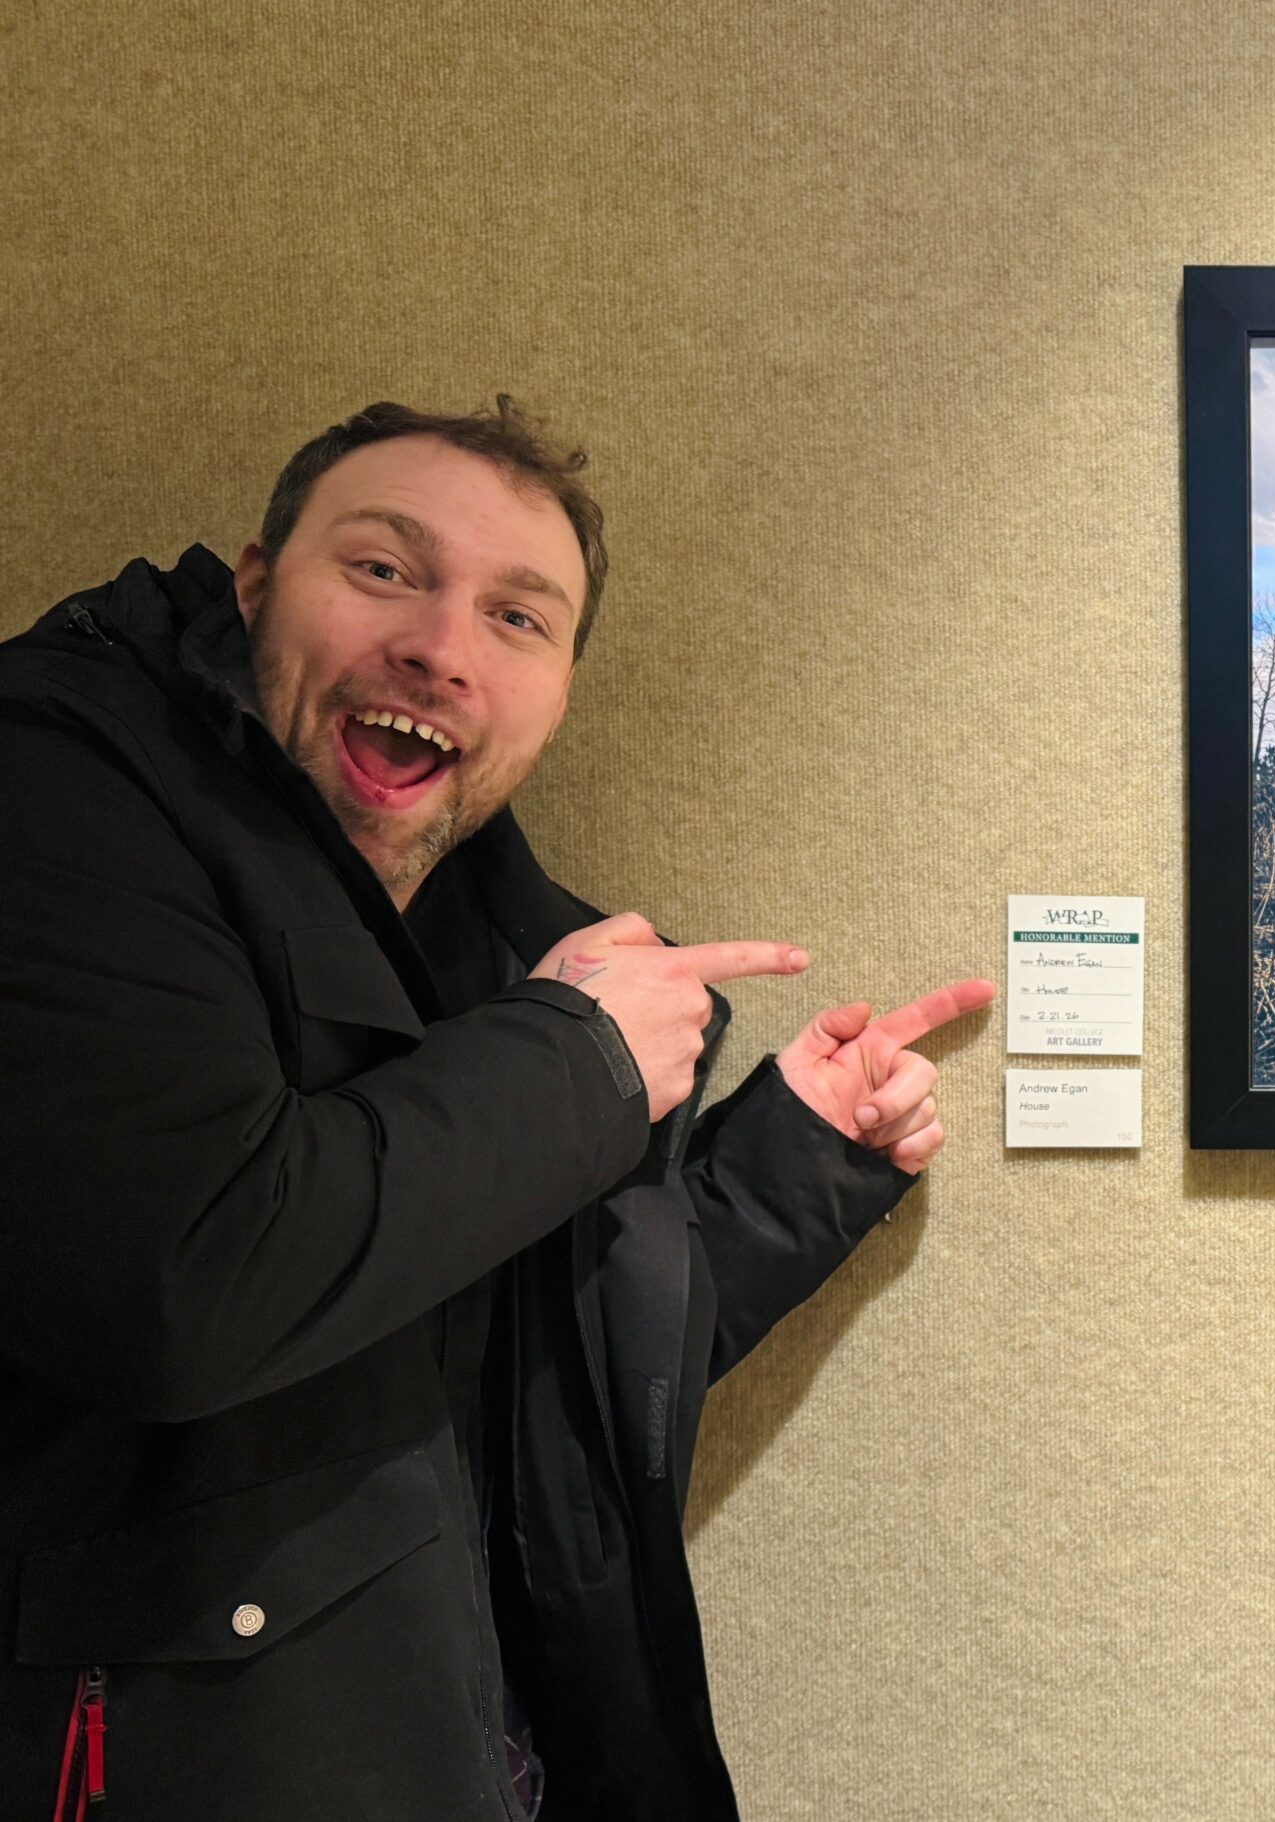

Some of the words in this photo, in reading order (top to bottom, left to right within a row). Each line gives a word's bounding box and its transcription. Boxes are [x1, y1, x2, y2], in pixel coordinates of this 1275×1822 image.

[1046, 909, 1104, 925] WRAP
[1020, 932, 1081, 942] HONORABLE
[1084, 934, 1131, 943] MENTION
[1047, 1037, 1063, 1046] ART
[1066, 1037, 1103, 1046] GALLERY
[1019, 1084, 1058, 1093] Andrew
[1061, 1084, 1088, 1095] Egan
[1020, 1102, 1050, 1110] House
[1019, 1120, 1068, 1130] Photograph
